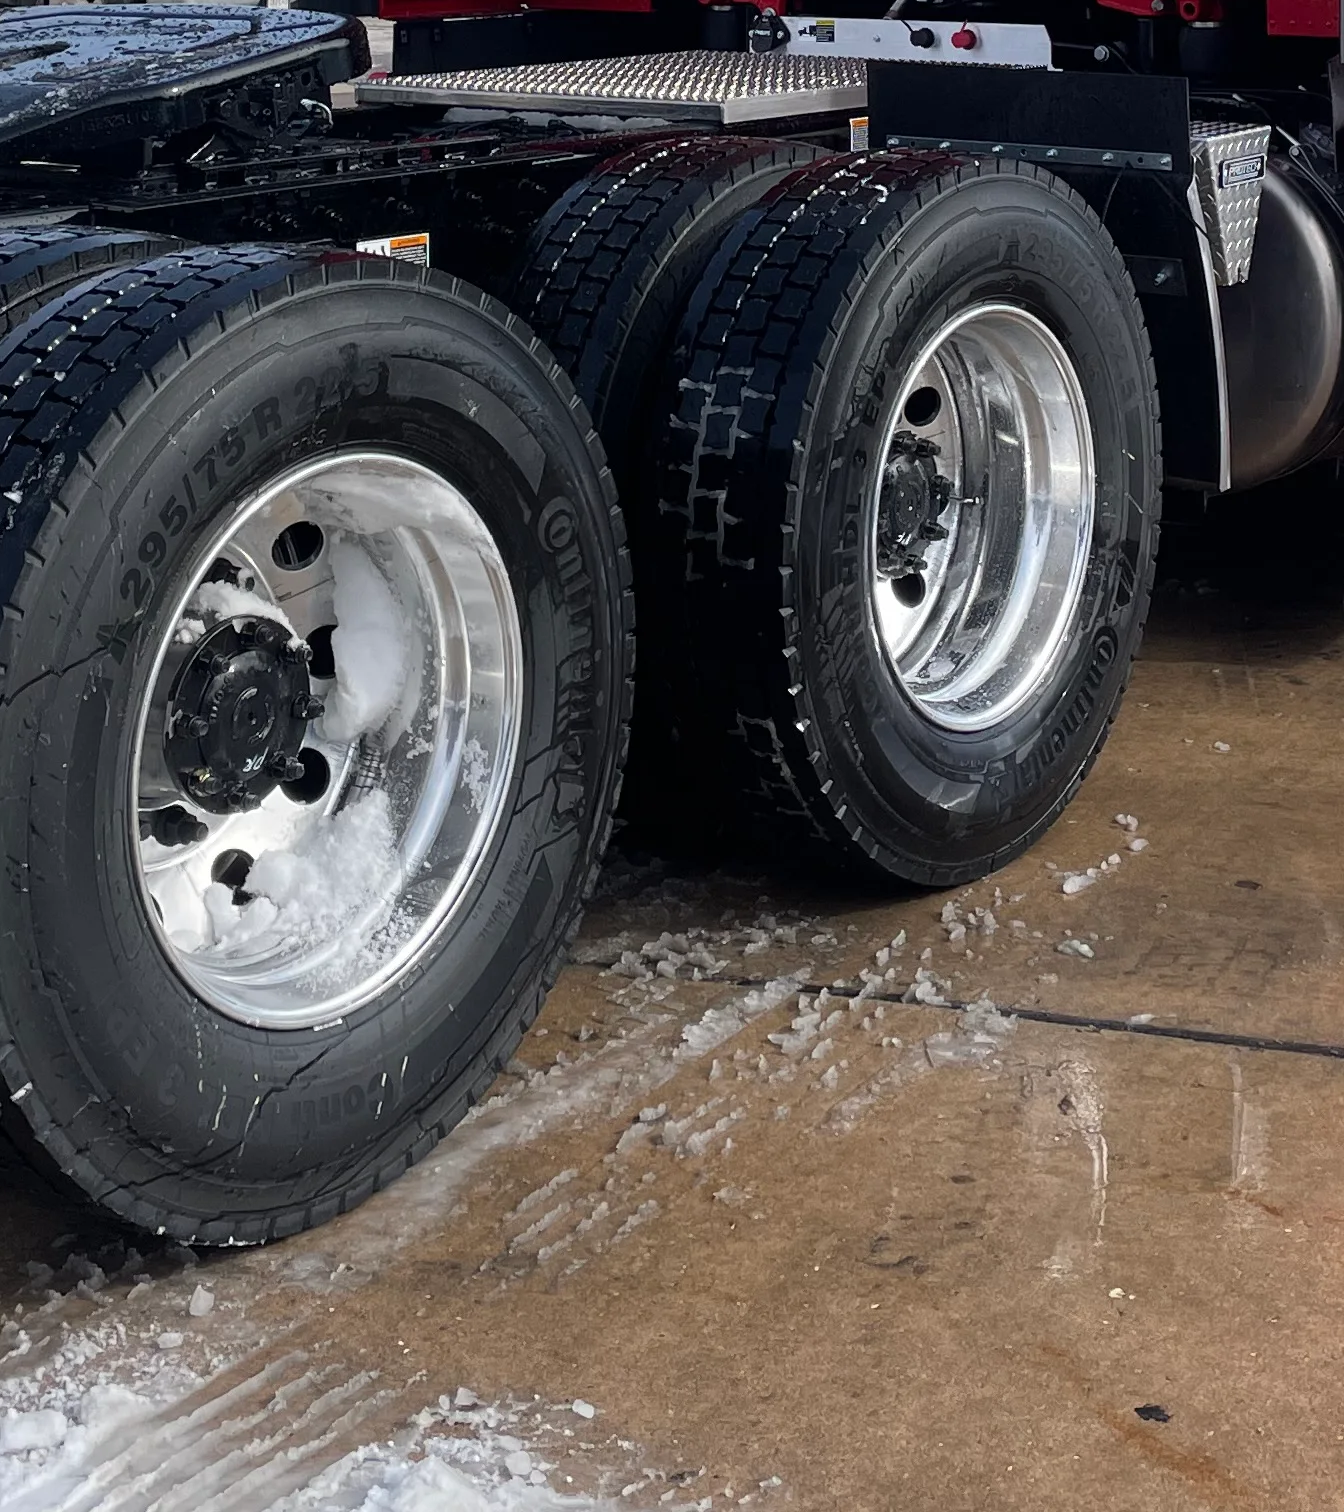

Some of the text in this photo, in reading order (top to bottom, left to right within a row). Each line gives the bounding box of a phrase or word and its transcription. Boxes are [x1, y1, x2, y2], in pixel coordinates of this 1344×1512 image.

[119, 425, 247, 609] 295/75
[537, 495, 594, 831] Continental
[1003, 624, 1121, 812] Continental
